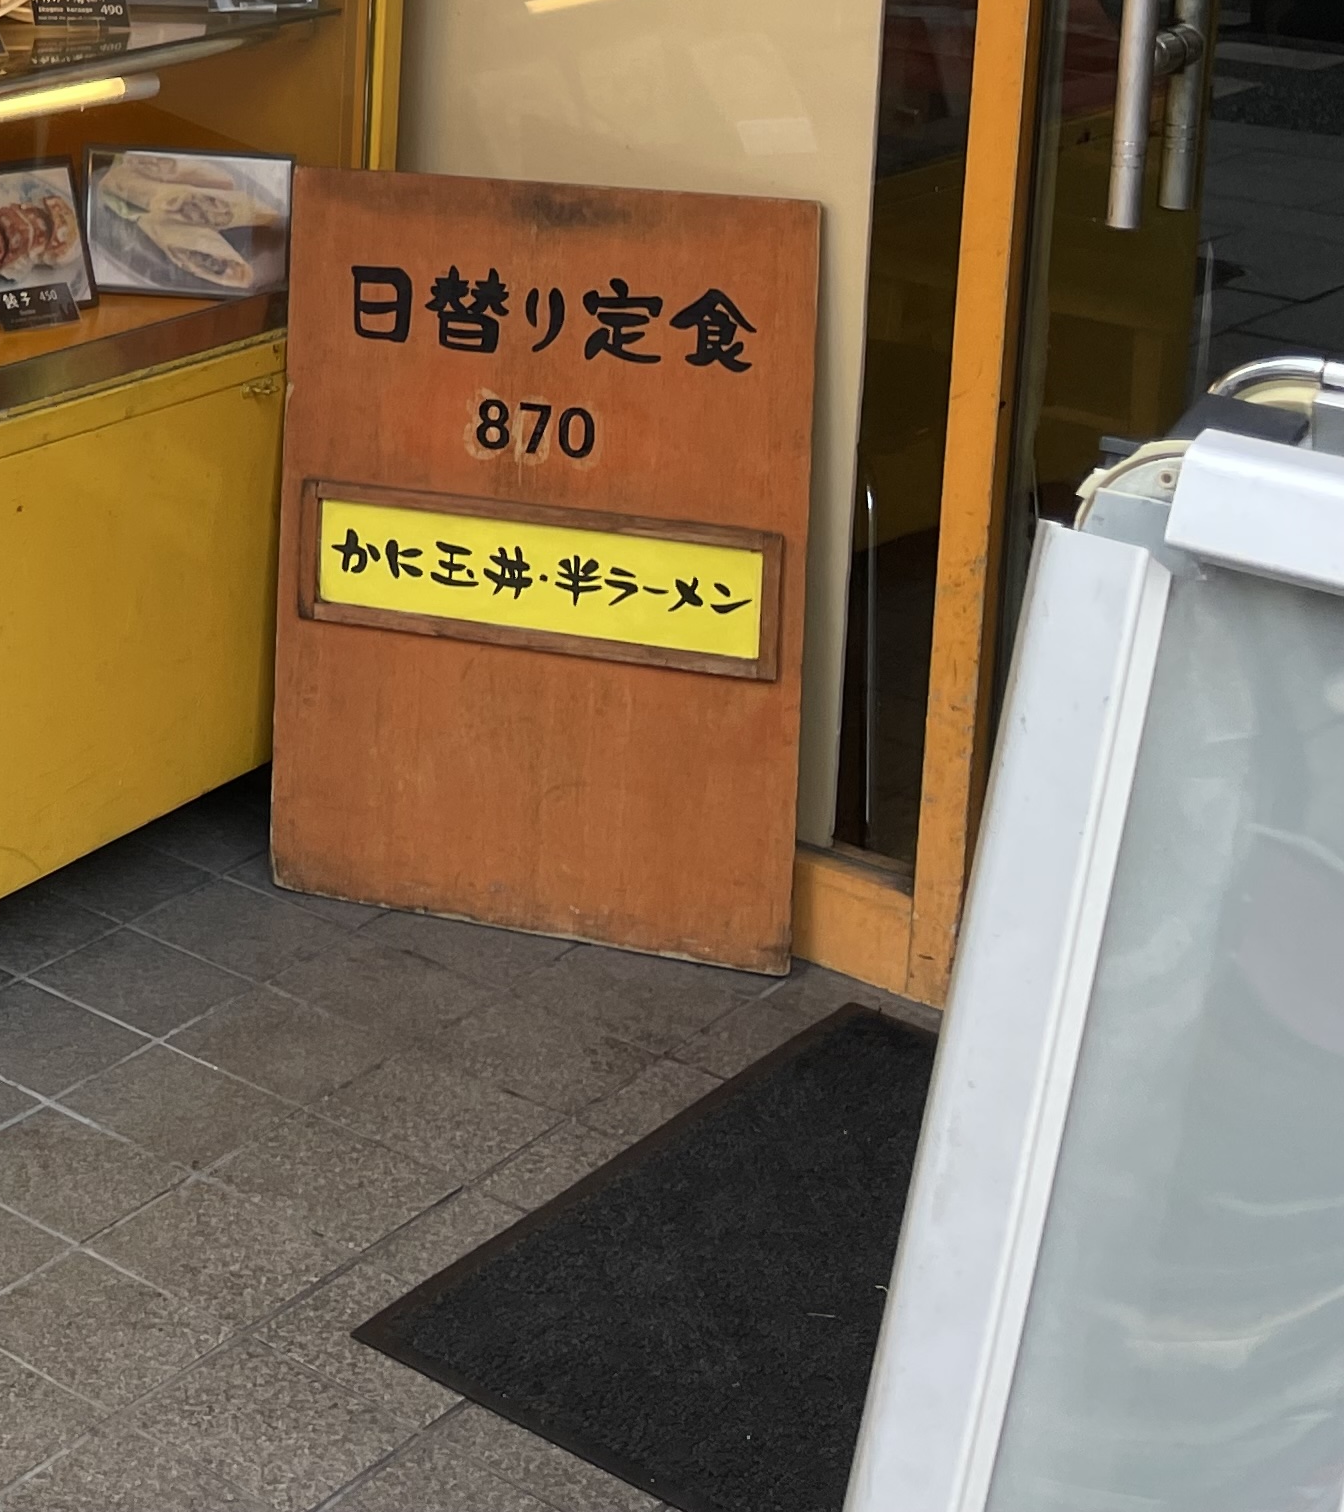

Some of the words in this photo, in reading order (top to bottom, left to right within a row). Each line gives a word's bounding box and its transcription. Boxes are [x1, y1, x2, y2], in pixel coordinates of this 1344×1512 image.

[100, 4, 123, 16] 490
[39, 289, 58, 302] 450
[351, 265, 757, 373] 日替り定食
[476, 398, 595, 459] 870
[332, 528, 752, 614] かに玉丼・半ラーメン
